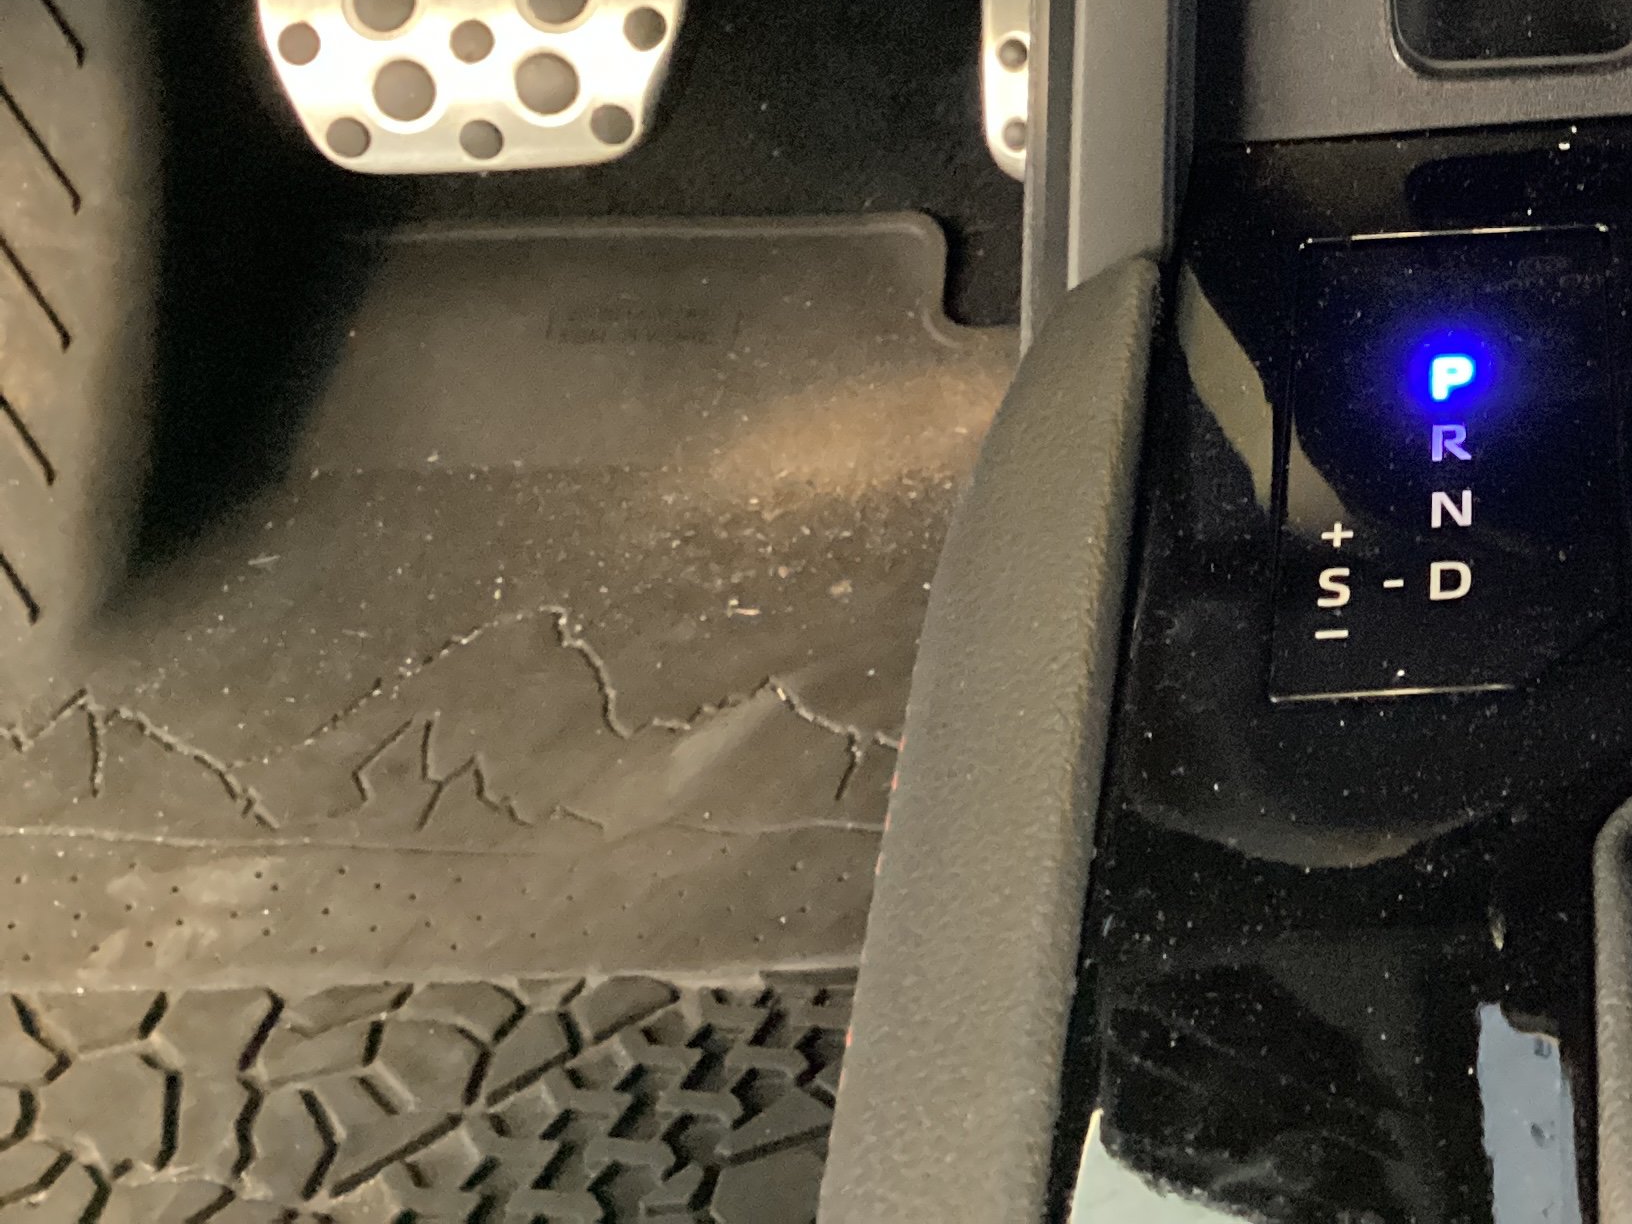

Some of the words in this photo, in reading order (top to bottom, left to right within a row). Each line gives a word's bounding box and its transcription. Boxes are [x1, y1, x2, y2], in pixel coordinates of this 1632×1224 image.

[1430, 355, 1475, 401] P
[1431, 423, 1472, 463] R
[1431, 489, 1473, 529] N
[1317, 566, 1351, 608] S
[1429, 560, 1472, 601] D
